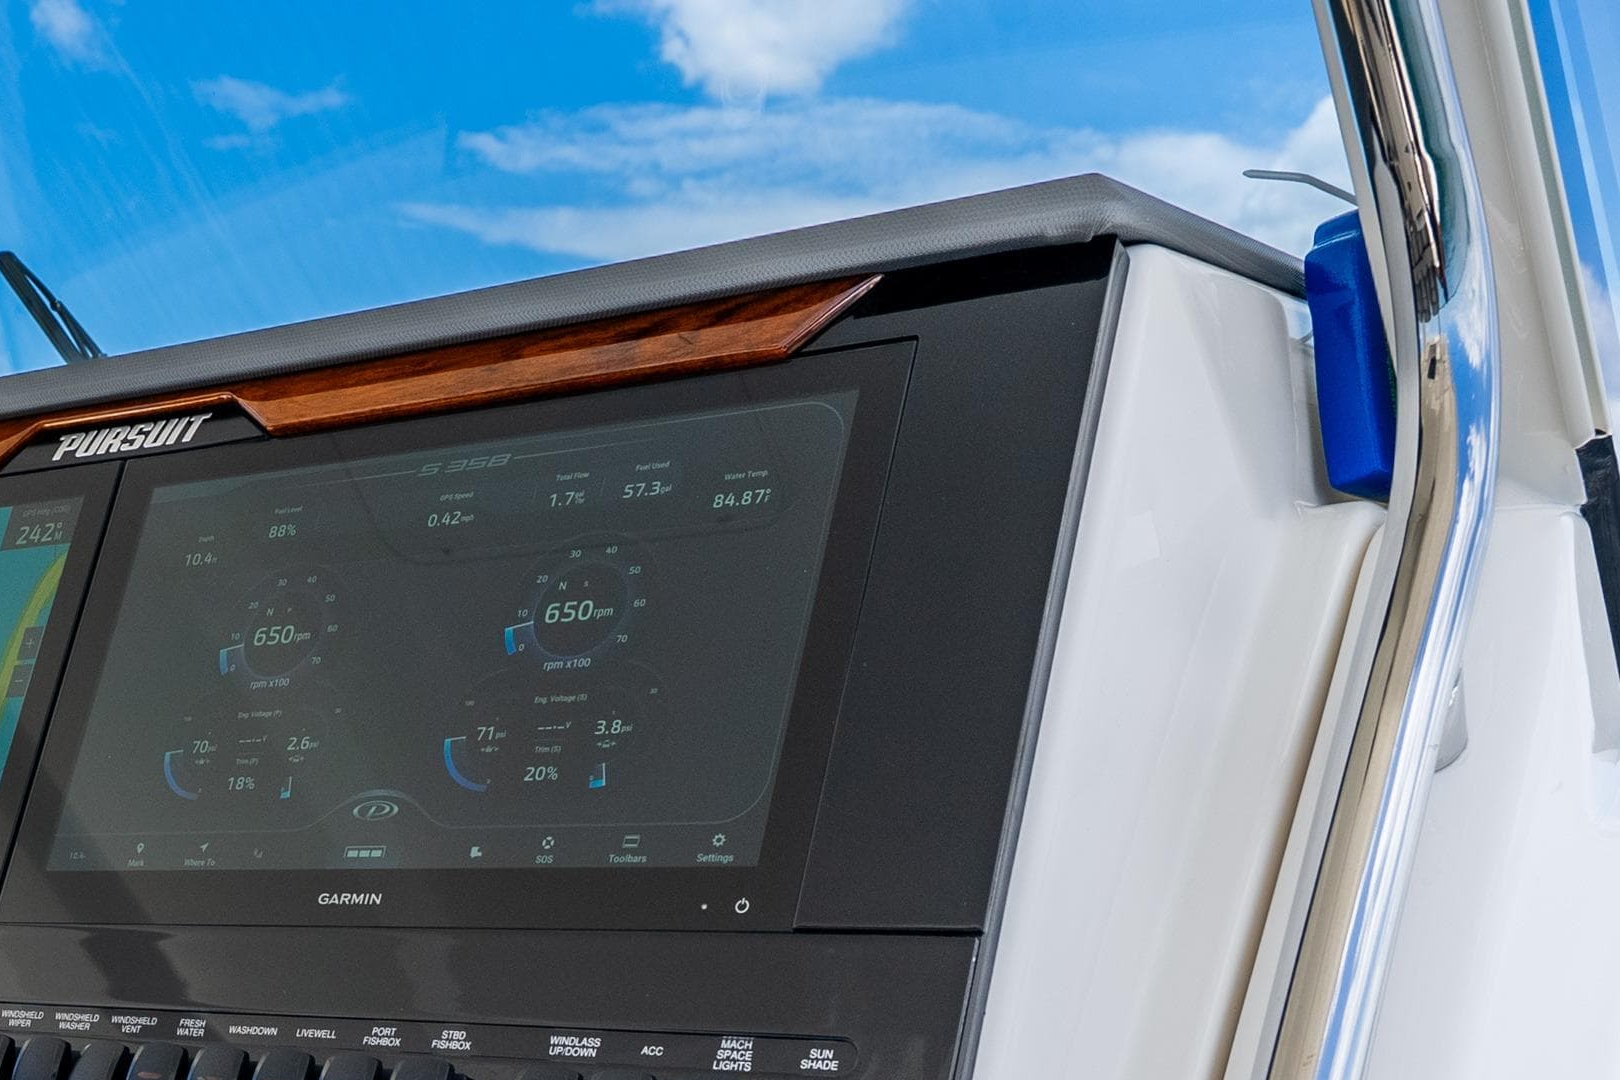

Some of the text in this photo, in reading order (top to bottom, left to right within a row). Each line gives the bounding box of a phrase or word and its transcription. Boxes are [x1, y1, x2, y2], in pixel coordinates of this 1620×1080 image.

[52, 412, 212, 461] PURSUIT
[636, 461, 670, 472] Fuel Used
[556, 474, 573, 482] Total
[724, 472, 746, 481] Water
[268, 524, 296, 538] 88%
[569, 550, 582, 558] 30
[606, 546, 618, 554] 40
[628, 566, 641, 574] 50
[536, 575, 548, 584] 20
[558, 582, 567, 590] N
[324, 594, 336, 603] 50
[633, 599, 646, 608] 60
[266, 608, 274, 616] N
[517, 609, 528, 618] 10
[327, 624, 338, 633] 60
[616, 635, 628, 643] 70
[311, 656, 322, 665] 70
[543, 658, 591, 672] rpm x100
[250, 678, 290, 690] rpm x100
[550, 694, 576, 704] Voltage
[524, 766, 558, 782] 20%
[228, 776, 256, 790] 18%
[535, 854, 554, 864] SOS
[608, 853, 648, 864] Toolbars
[696, 853, 734, 864] Settings
[317, 892, 383, 906] GARMIN
[2, 1010, 44, 1020] WINDSHIELD
[55, 1012, 100, 1023] WINDSHIELD
[112, 1015, 158, 1026] WINDSHIELD
[8, 1018, 32, 1028] WIPER
[59, 1021, 91, 1031] WASHER
[180, 1018, 206, 1028] FRESH
[122, 1024, 142, 1034] VENT
[176, 1027, 204, 1037] WATER
[228, 1025, 278, 1036] WASHDOWN
[296, 1028, 336, 1040] LIVEWELL
[372, 1026, 396, 1037] PORT
[442, 1030, 466, 1041] STBD
[363, 1036, 402, 1047] FISHBOX
[432, 1040, 472, 1051] FISHBOX
[550, 1035, 600, 1048] WINDLASS
[720, 1039, 753, 1050] MACH
[548, 1046, 597, 1058] UP/DOWN
[641, 1046, 664, 1056] ACC
[716, 1050, 753, 1061] SPACE
[810, 1048, 834, 1060] SUN
[712, 1060, 752, 1072] LIGHTS
[800, 1059, 839, 1071] SHADE
